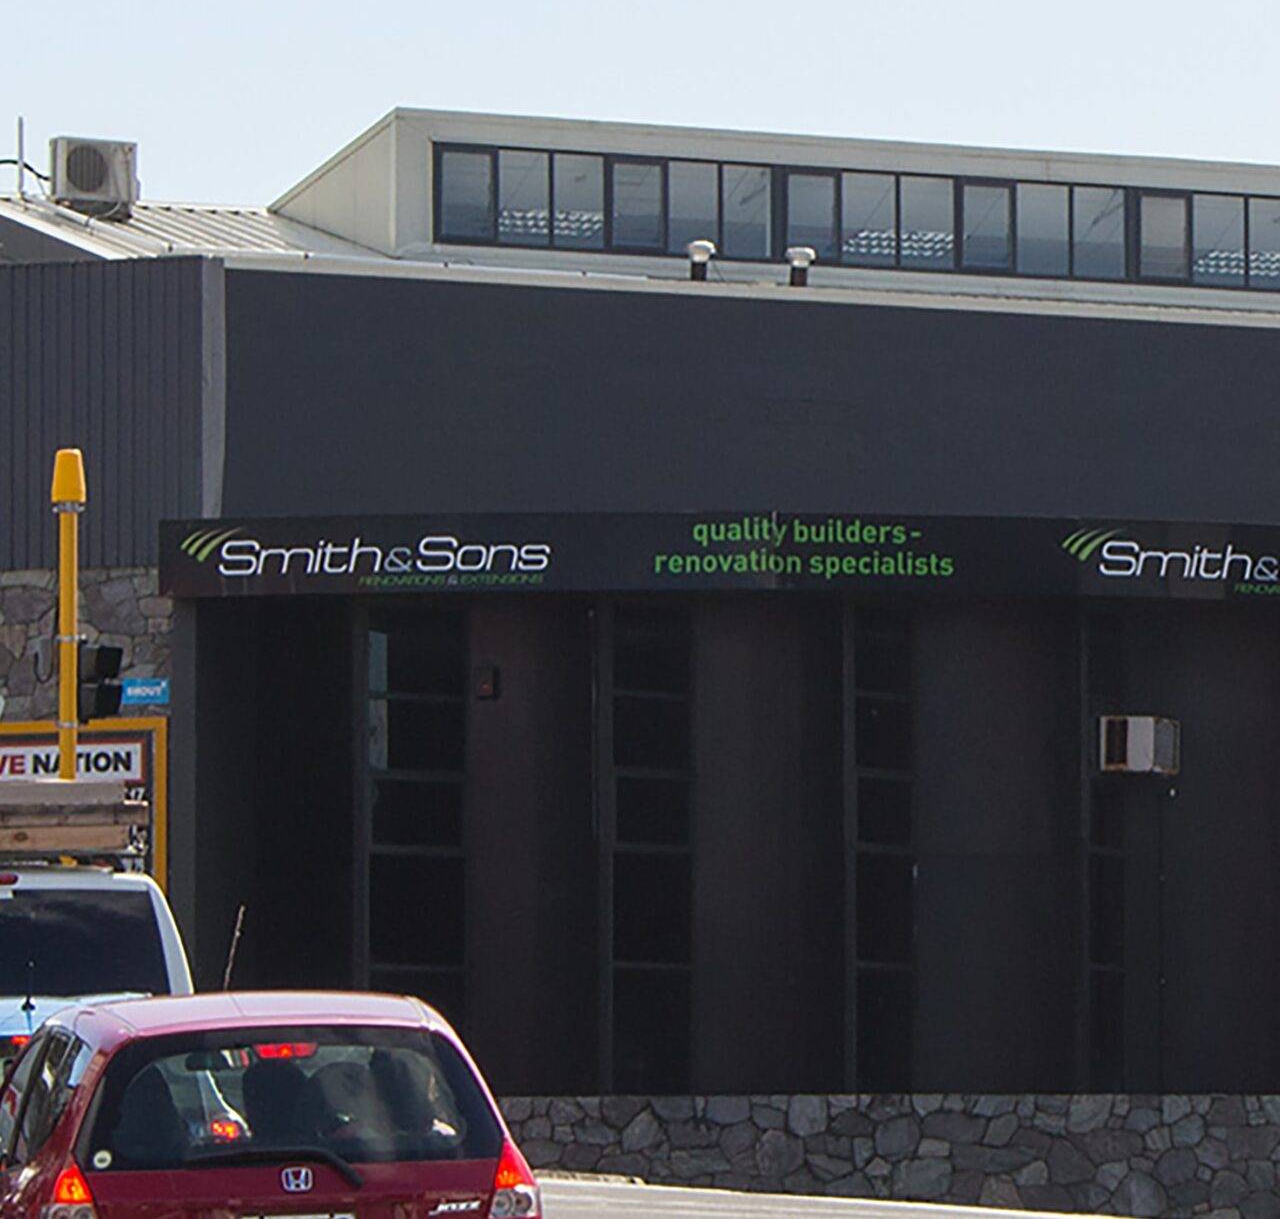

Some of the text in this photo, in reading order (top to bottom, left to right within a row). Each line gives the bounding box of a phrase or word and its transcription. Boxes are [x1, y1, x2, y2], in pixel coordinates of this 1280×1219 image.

[692, 518, 787, 547] quality
[654, 549, 954, 578] renovation specialists
